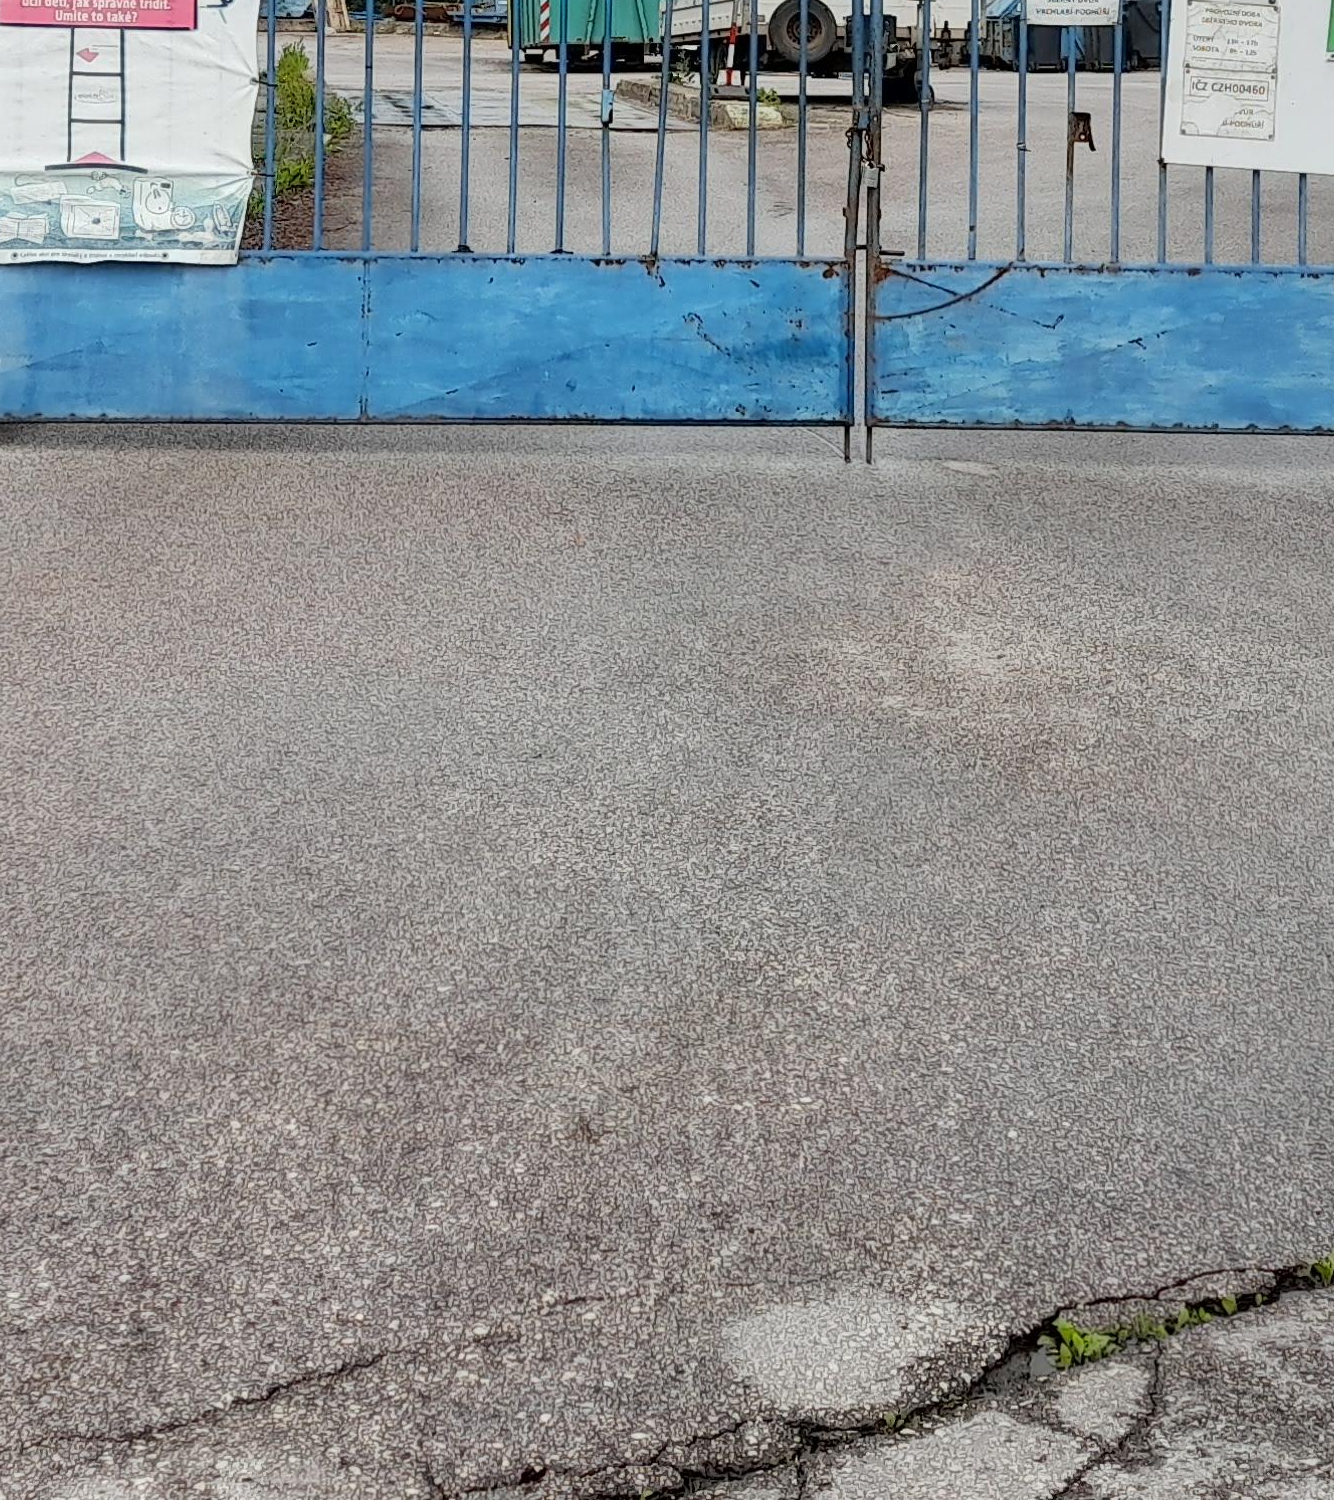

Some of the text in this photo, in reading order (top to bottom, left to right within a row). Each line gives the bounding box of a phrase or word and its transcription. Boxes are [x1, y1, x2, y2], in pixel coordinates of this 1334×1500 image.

[91, 11, 104, 22] to
[106, 11, 138, 23] také?
[1192, 79, 1266, 95] IČZ CZH00460
